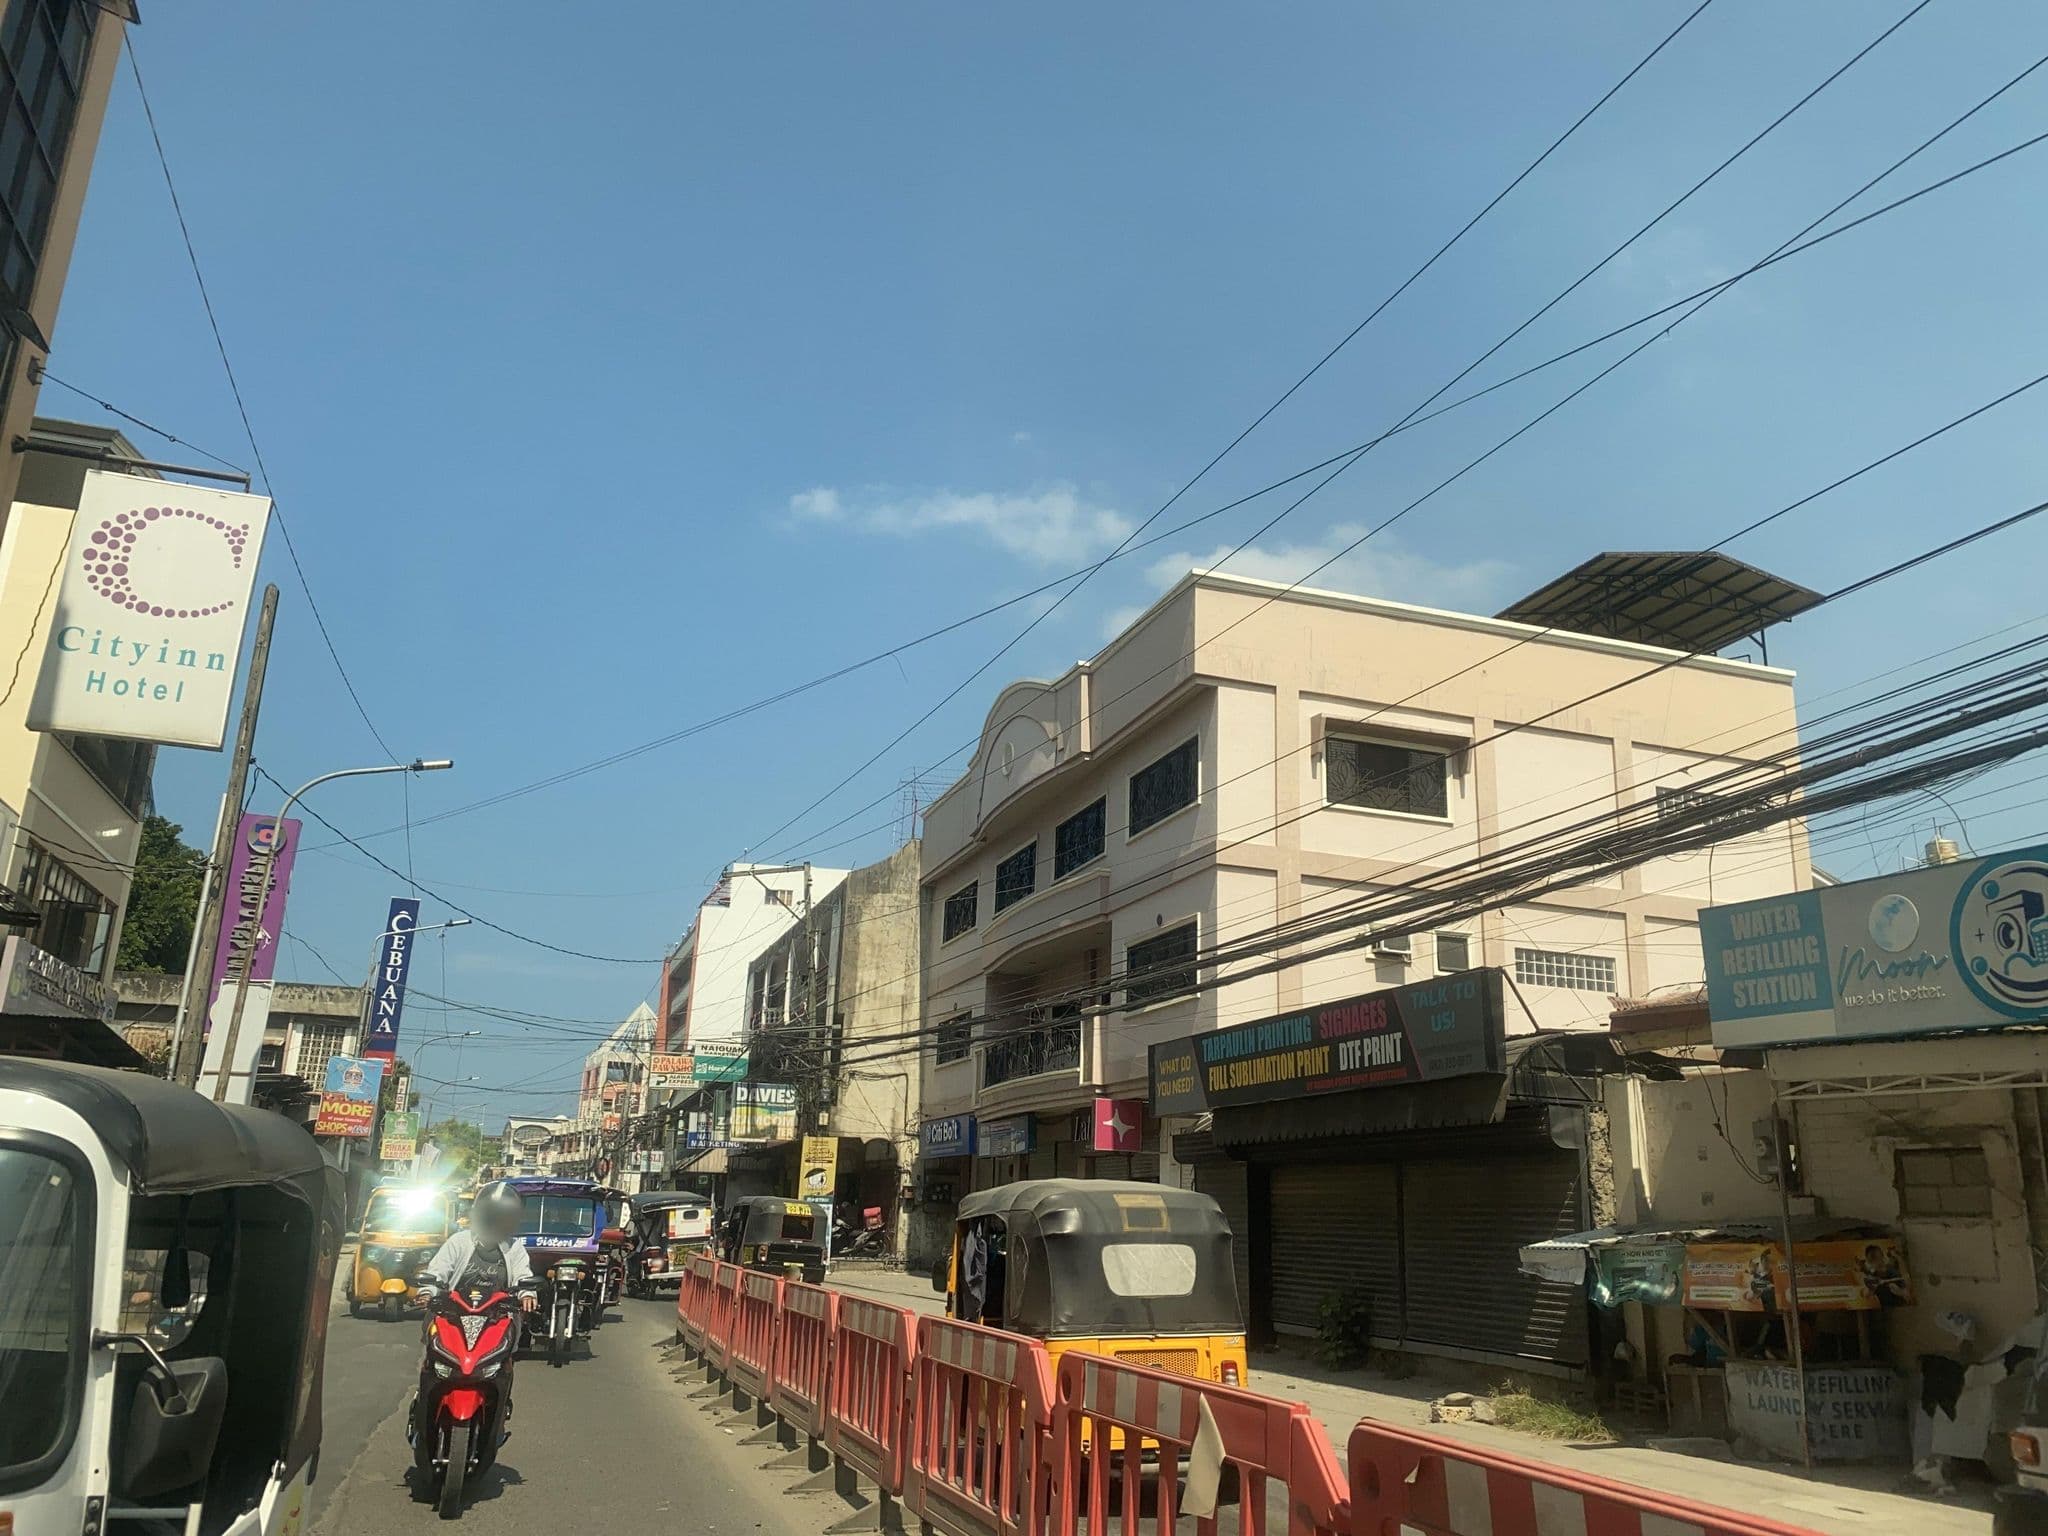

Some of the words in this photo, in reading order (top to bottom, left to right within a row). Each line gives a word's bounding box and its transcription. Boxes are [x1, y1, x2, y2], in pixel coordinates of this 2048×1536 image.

[57, 625, 226, 672] Cityinn
[86, 670, 184, 703] Hotel
[1731, 904, 1800, 941] WATER
[1722, 936, 1820, 976] REFILLING
[376, 911, 413, 1033] CEBUANA
[1837, 944, 1949, 995] Moon
[1410, 985, 1448, 1009] TALK
[1454, 980, 1476, 1002] TO
[1734, 972, 1817, 1008] STATION
[1845, 993, 1865, 1007] we
[1868, 989, 1885, 1005] do
[1887, 987, 1898, 1003] it
[1202, 1028, 1256, 1063] TARPAULIN
[1258, 1015, 1312, 1053] PRINTING
[1319, 999, 1388, 1039] SIGNAGES
[1431, 1011, 1455, 1033] US!
[652, 1064, 693, 1073] PAWNSHO
[661, 1057, 693, 1065] PALAWA
[1159, 1057, 1180, 1076] WHAT
[1180, 1055, 1192, 1073] DO
[1208, 1066, 1229, 1092] FULL
[1230, 1052, 1295, 1087] SUBLIMATION
[1296, 1046, 1330, 1078] PRINT
[1338, 1042, 1363, 1071] DTF
[1363, 1032, 1402, 1067] PRINT
[736, 1087, 796, 1104] DAVIES
[1156, 1080, 1171, 1097] YOU
[321, 1102, 374, 1117] MORE
[317, 1121, 348, 1133] SHOPS
[1745, 1367, 1800, 1390] WATER
